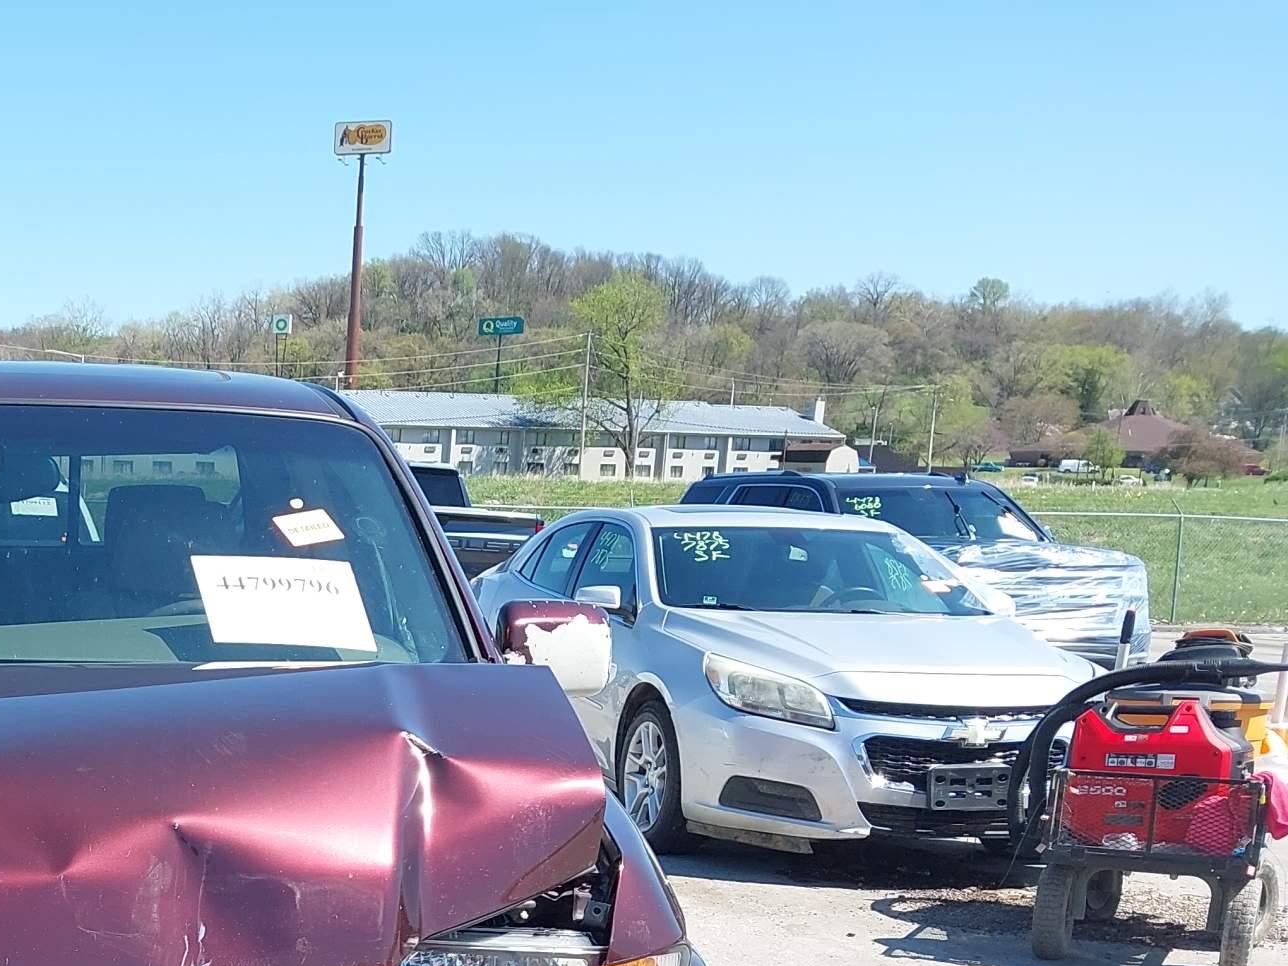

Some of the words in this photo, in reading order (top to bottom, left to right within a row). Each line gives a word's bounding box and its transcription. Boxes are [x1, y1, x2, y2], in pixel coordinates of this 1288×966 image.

[495, 319, 518, 329] Quality
[694, 550, 731, 562] SF
[216, 576, 340, 596] 44799796
